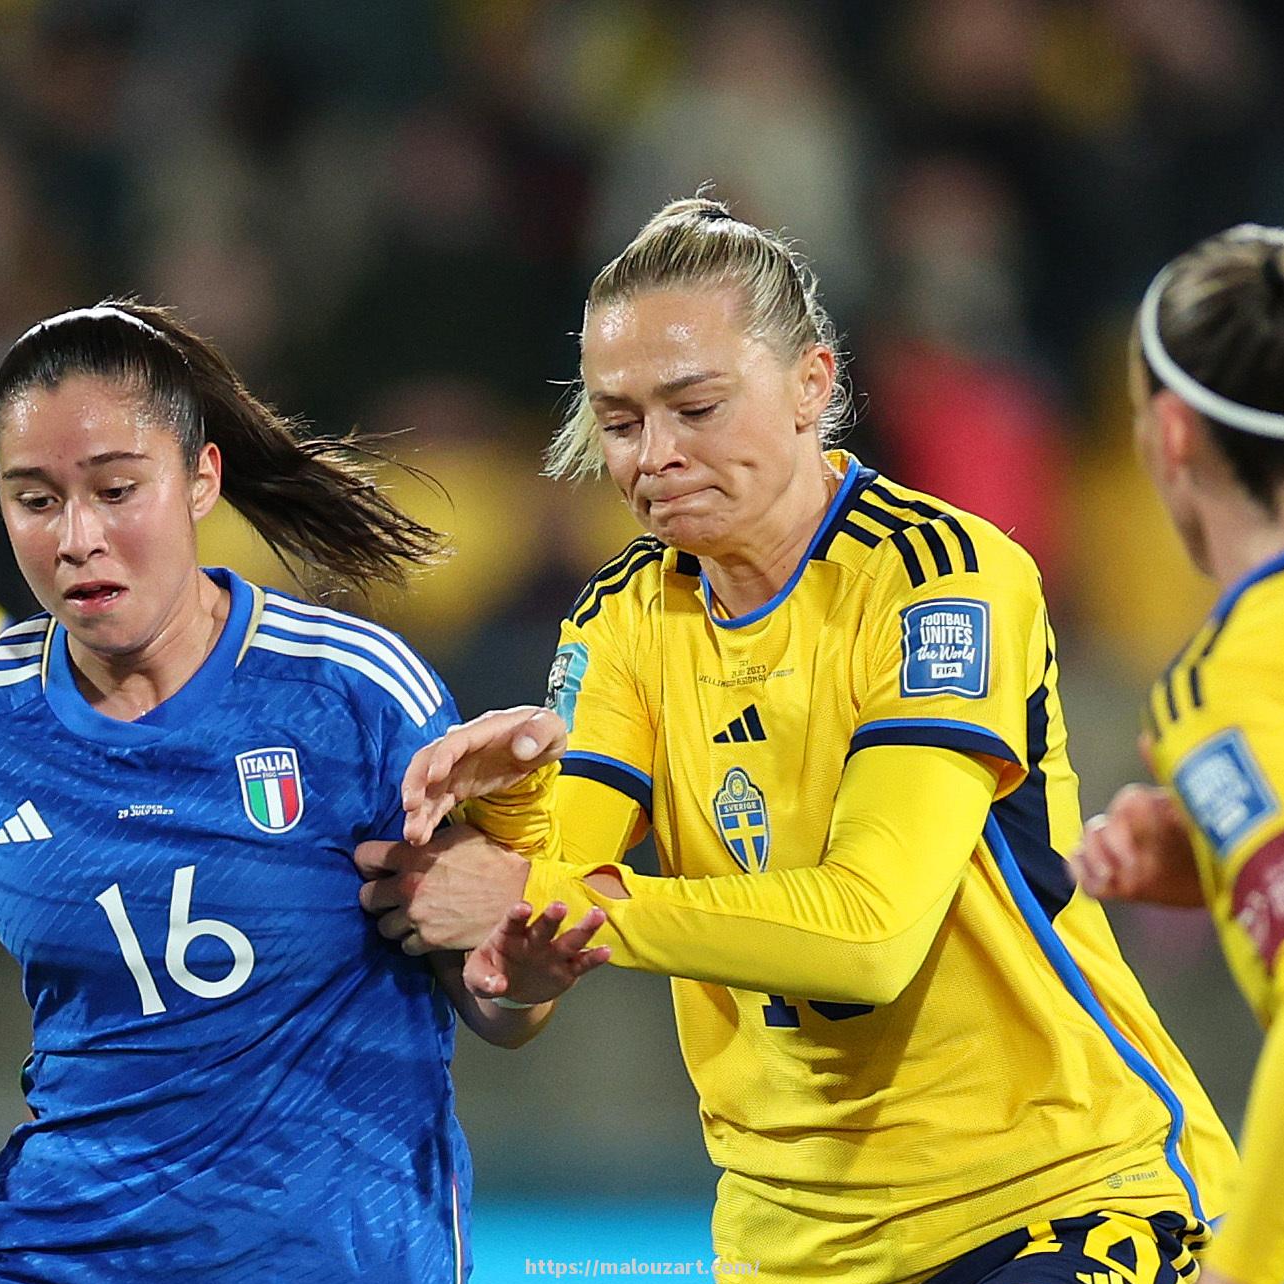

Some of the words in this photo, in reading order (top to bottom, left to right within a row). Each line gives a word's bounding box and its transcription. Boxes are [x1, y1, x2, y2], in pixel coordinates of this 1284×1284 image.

[921, 612, 973, 627] FOOTBALL
[920, 626, 973, 646] UNITES
[917, 646, 938, 661] the
[939, 646, 975, 664] World
[936, 666, 957, 675] FIFA
[242, 754, 292, 774] ITALIA
[95, 865, 255, 1016] 16
